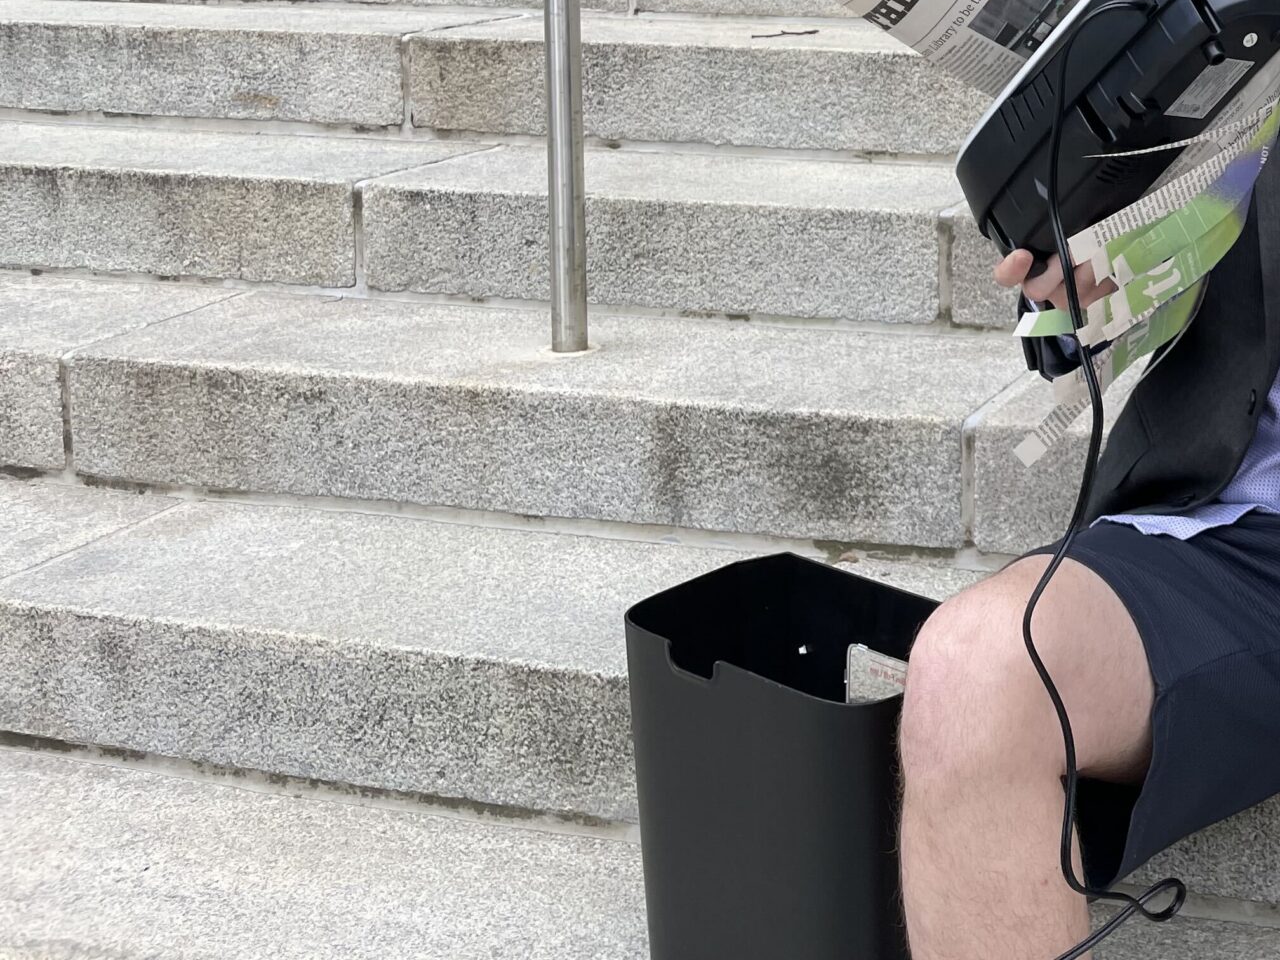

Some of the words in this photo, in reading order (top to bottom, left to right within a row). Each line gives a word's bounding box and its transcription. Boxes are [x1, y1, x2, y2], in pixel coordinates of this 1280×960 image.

[928, 26, 957, 51] Library
[953, 16, 965, 27] to
[959, 4, 975, 17] be
[1260, 146, 1269, 164] NOT
